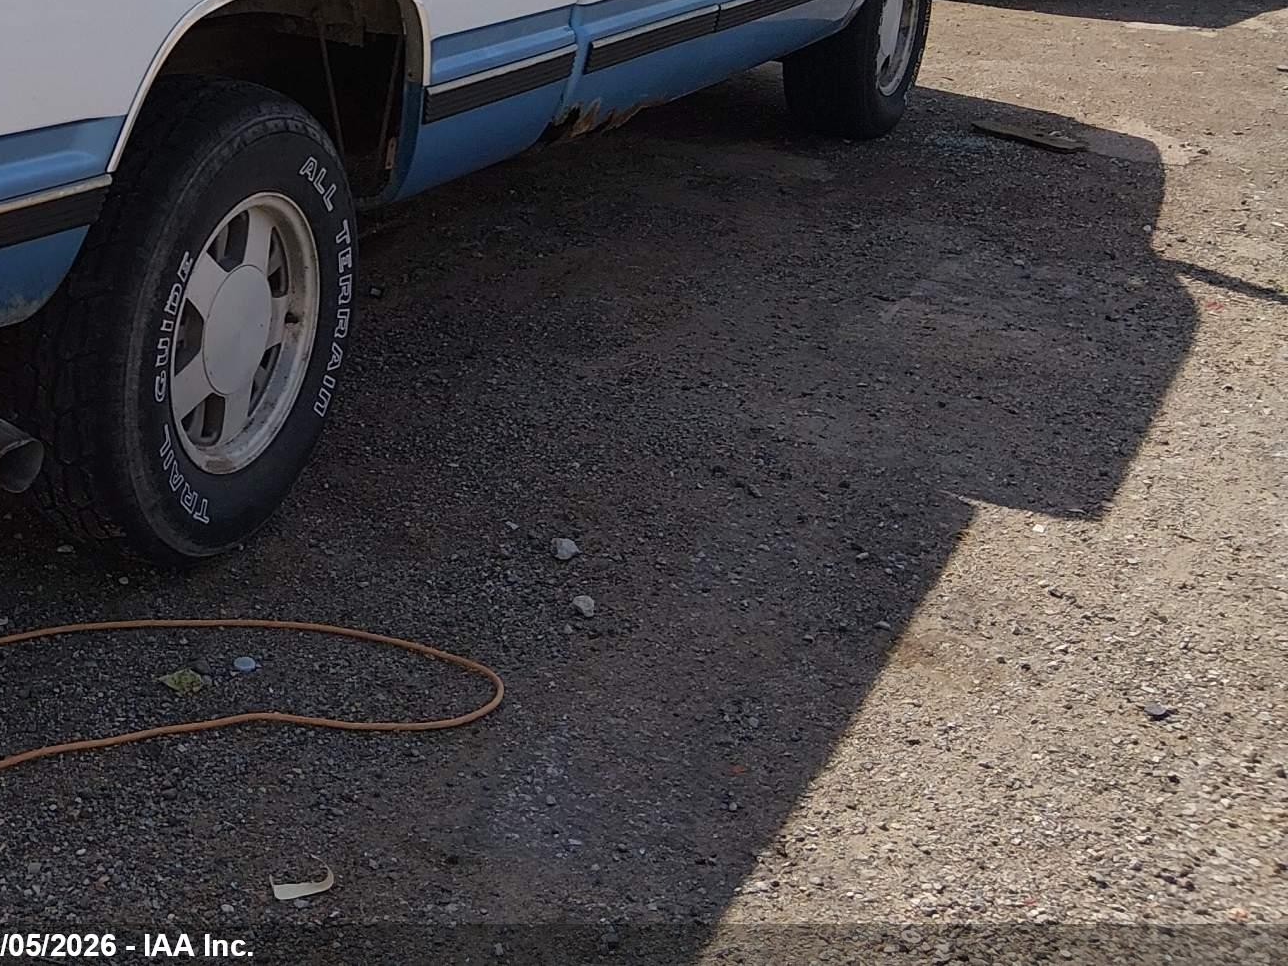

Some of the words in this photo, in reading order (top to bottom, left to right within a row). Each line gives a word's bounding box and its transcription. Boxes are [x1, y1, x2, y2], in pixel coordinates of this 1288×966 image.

[299, 156, 337, 212] ALL
[154, 250, 194, 403] GUIDE
[312, 219, 353, 418] TERRAIN
[159, 424, 210, 524] TRAIL
